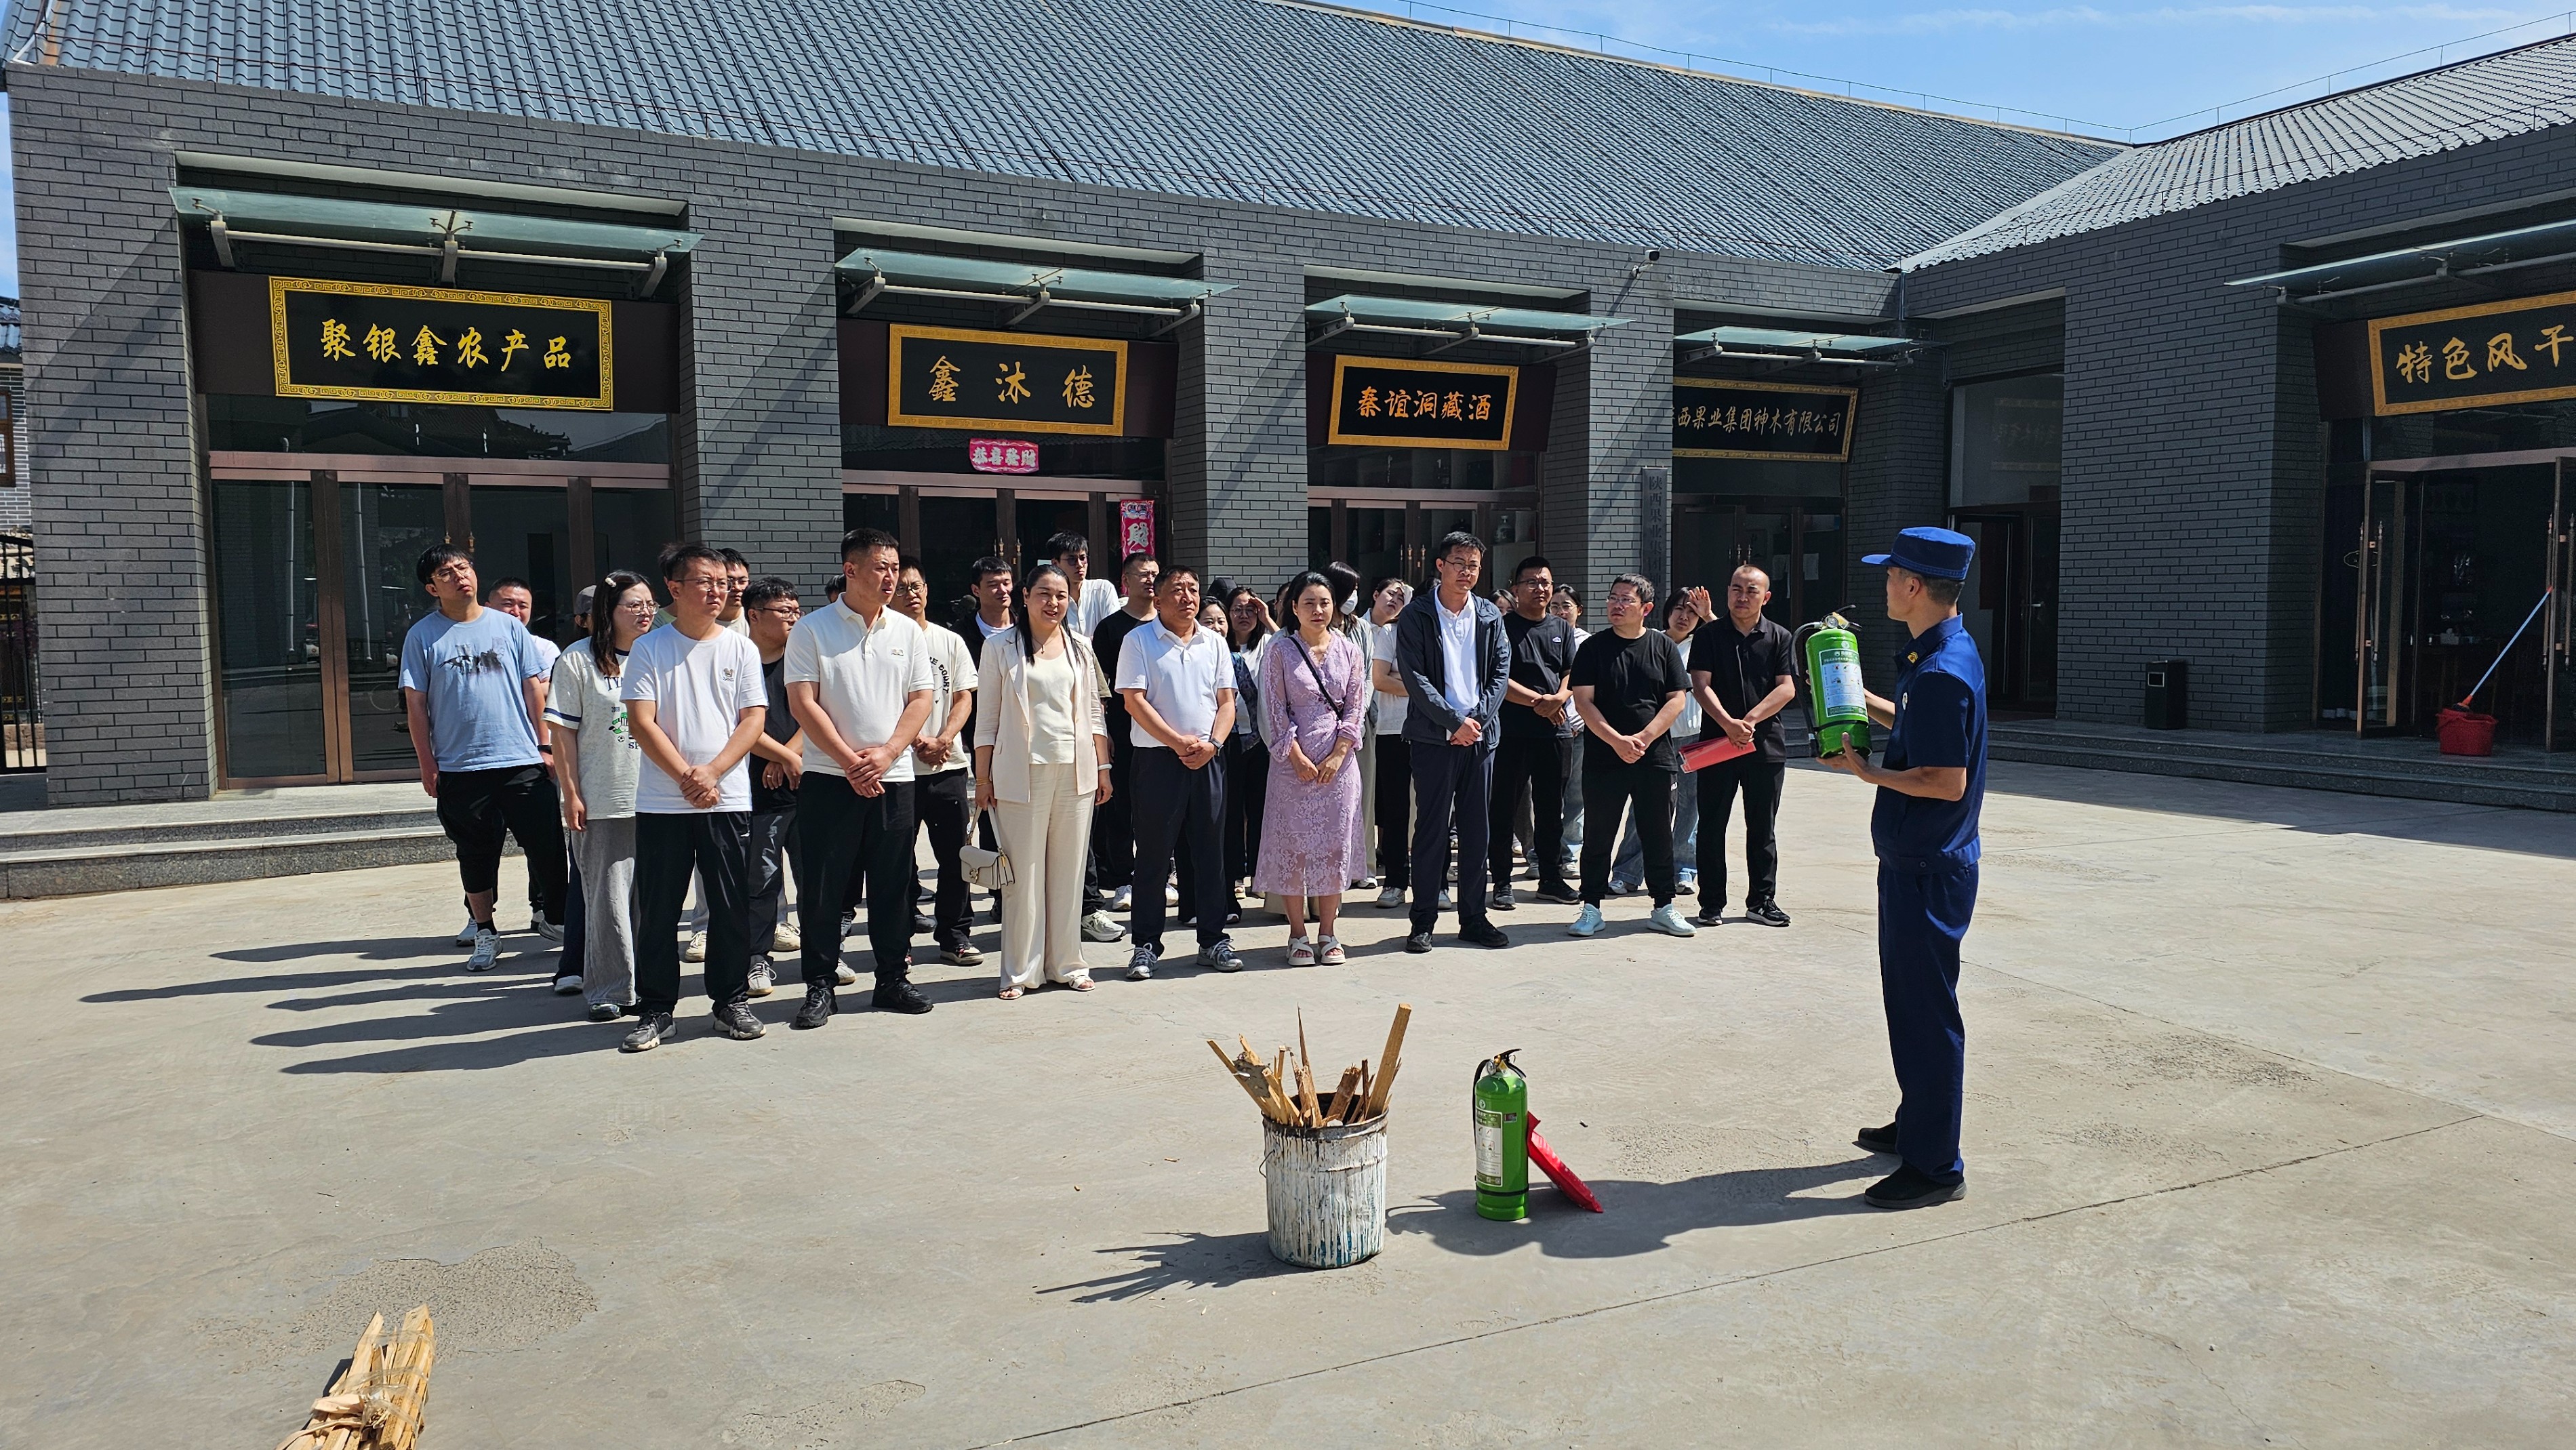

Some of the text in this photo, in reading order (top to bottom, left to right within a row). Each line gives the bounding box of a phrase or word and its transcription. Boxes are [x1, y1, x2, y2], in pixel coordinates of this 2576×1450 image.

[320, 319, 572, 372] 聚银鑫农产品
[2396, 325, 2574, 384] 特色风干
[928, 356, 1096, 408] 鑫沐德
[1356, 386, 1492, 422] 秦谊洞藏酒
[1672, 405, 1841, 437] 西果业集团神木有限公司
[1127, 521, 1150, 554] 財
